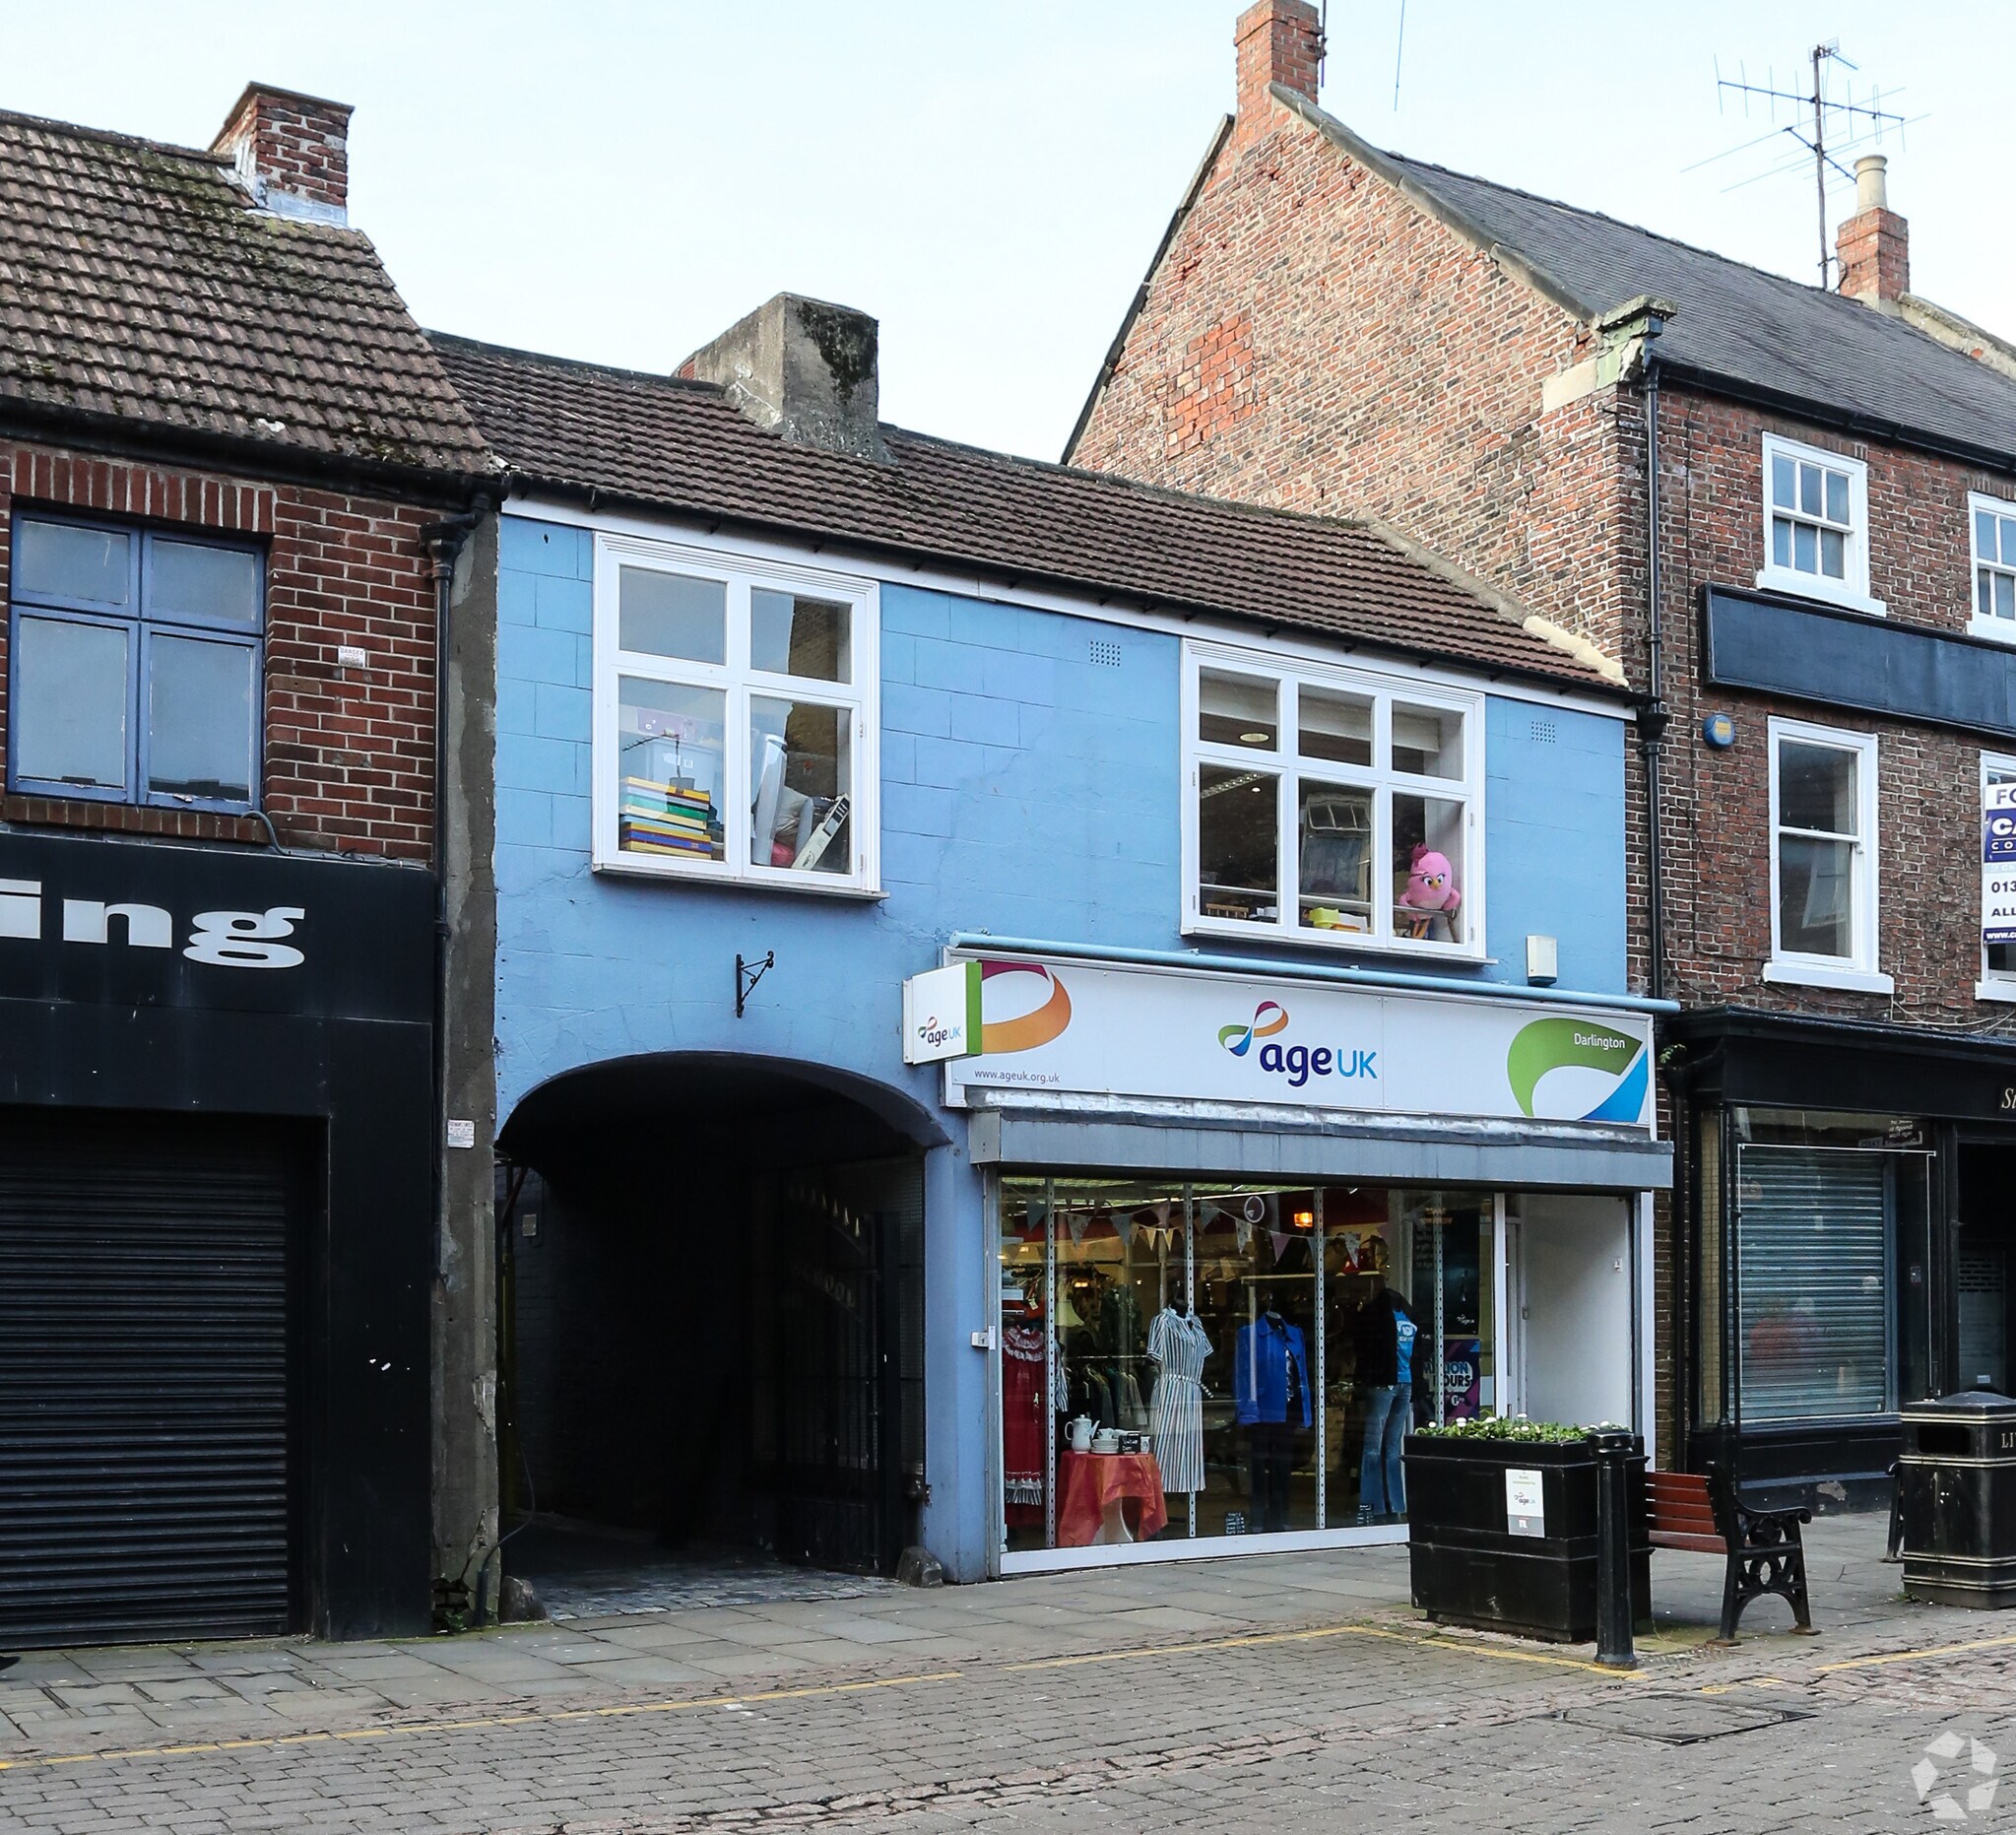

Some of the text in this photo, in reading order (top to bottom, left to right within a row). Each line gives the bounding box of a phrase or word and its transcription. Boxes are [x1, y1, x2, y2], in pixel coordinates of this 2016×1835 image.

[1991, 817, 2016, 836] C
[0, 878, 305, 969] ing
[927, 1029, 948, 1048] age
[1574, 1032, 1626, 1051] Darlington
[1259, 1043, 1378, 1087] age UK
[974, 1070, 1061, 1084] www.ageuk.org.uk
[2001, 1087, 2016, 1109] S
[2001, 1431, 2016, 1448] LI
